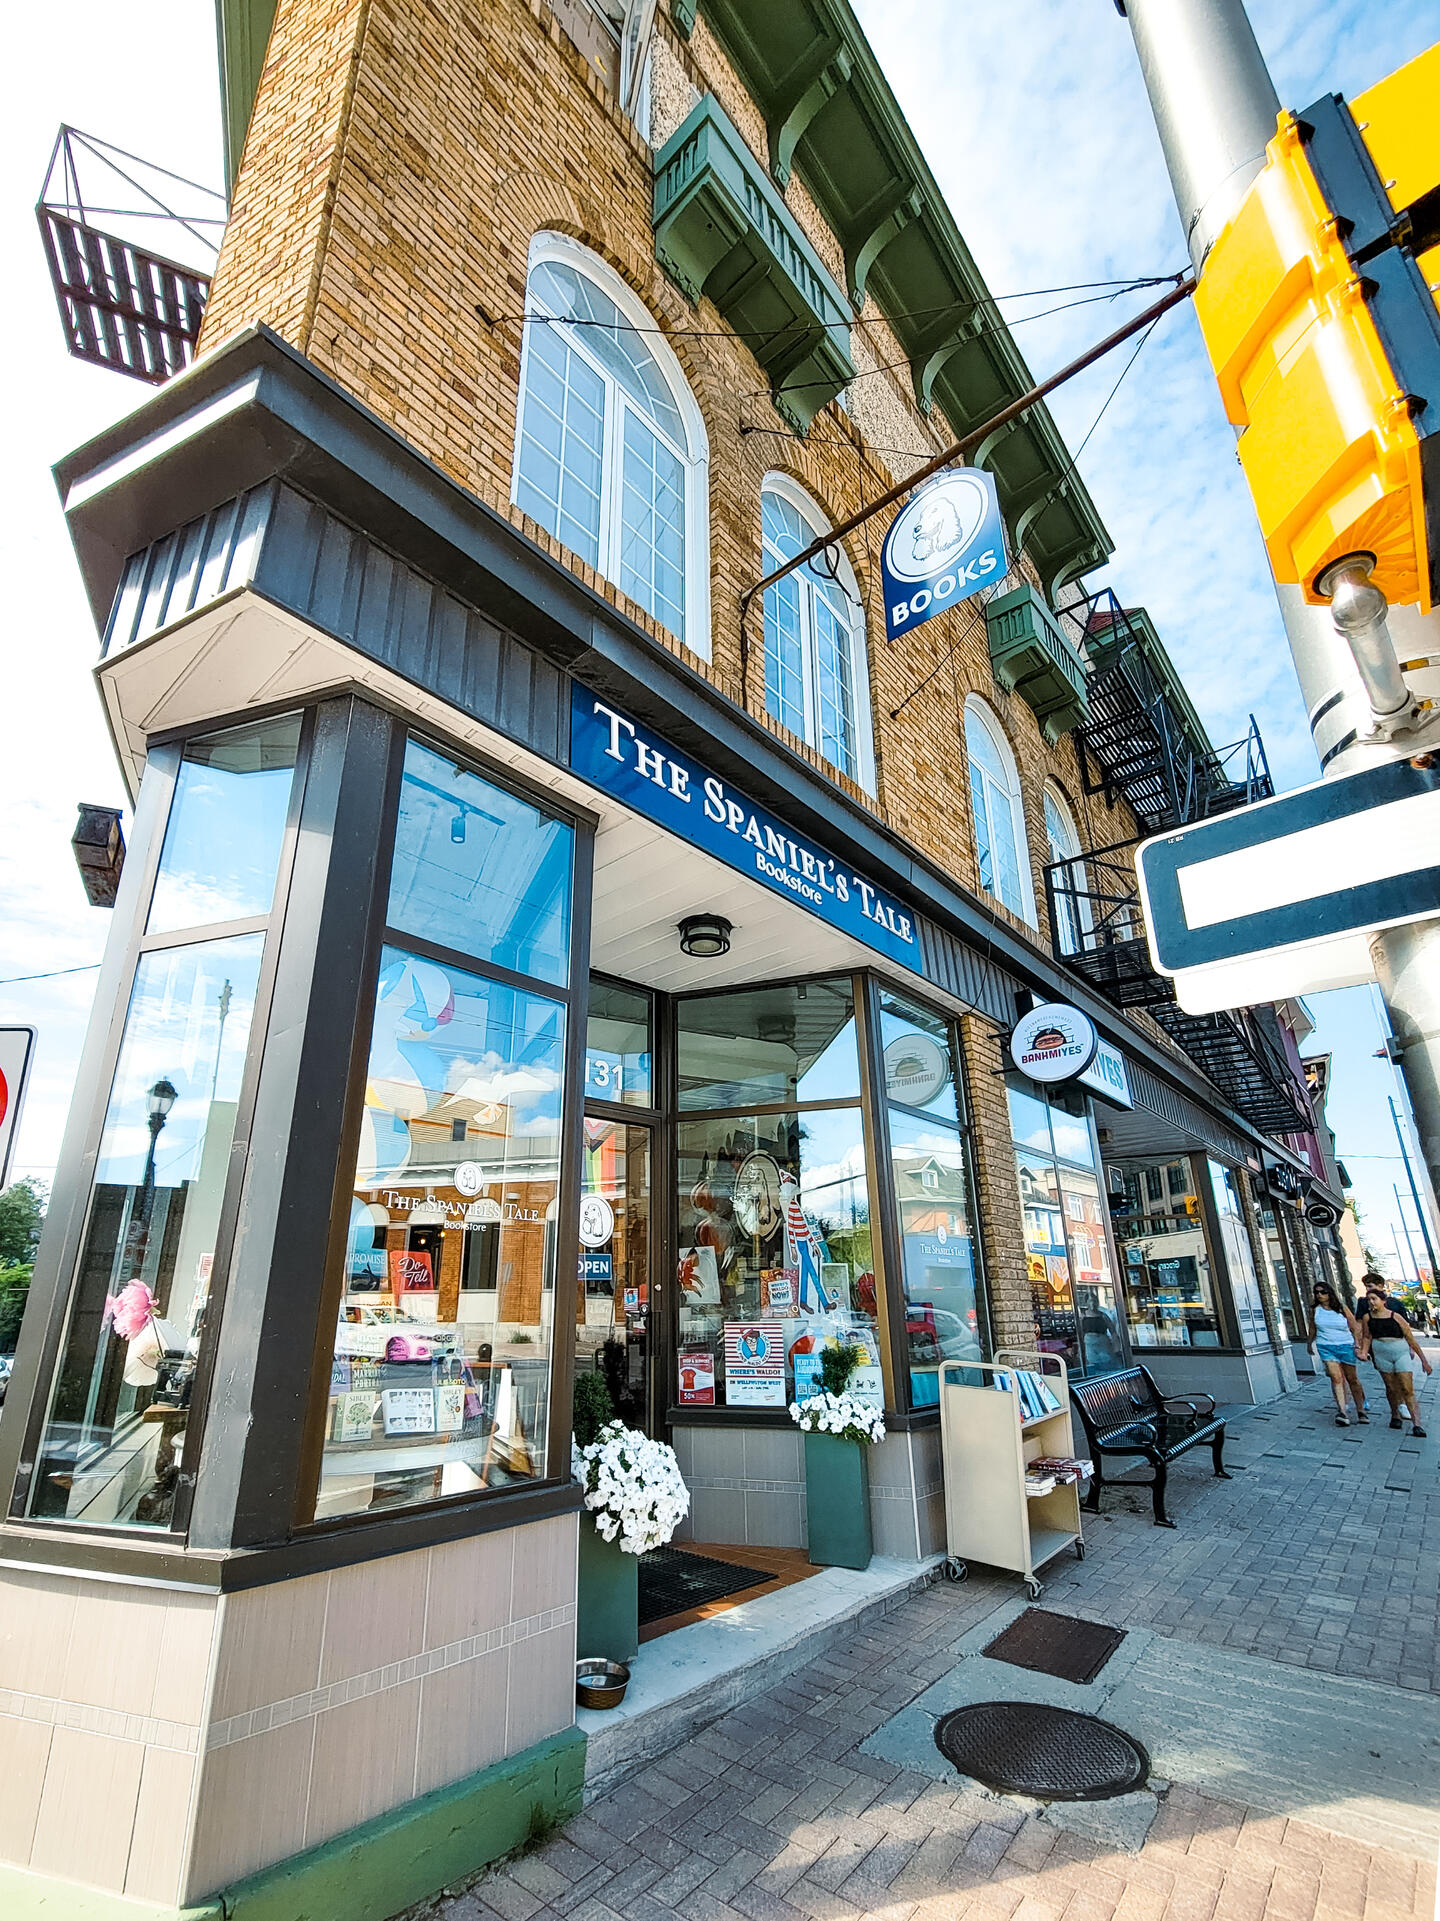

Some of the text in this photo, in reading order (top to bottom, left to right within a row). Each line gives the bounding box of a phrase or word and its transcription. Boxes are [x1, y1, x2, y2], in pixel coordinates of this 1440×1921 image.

[892, 549, 997, 627] BOOKS
[593, 701, 914, 944] THE SPANIEL'S TALE
[756, 851, 823, 905] Bookstore
[585, 1057, 623, 1091] 131
[382, 1190, 539, 1221] THE SPANIEL'S TALE
[443, 1219, 487, 1232] Bookstore
[349, 1253, 385, 1265] PROMISE
[397, 1256, 424, 1272] Do
[578, 1261, 609, 1274] OPEN
[404, 1269, 429, 1287] Tell
